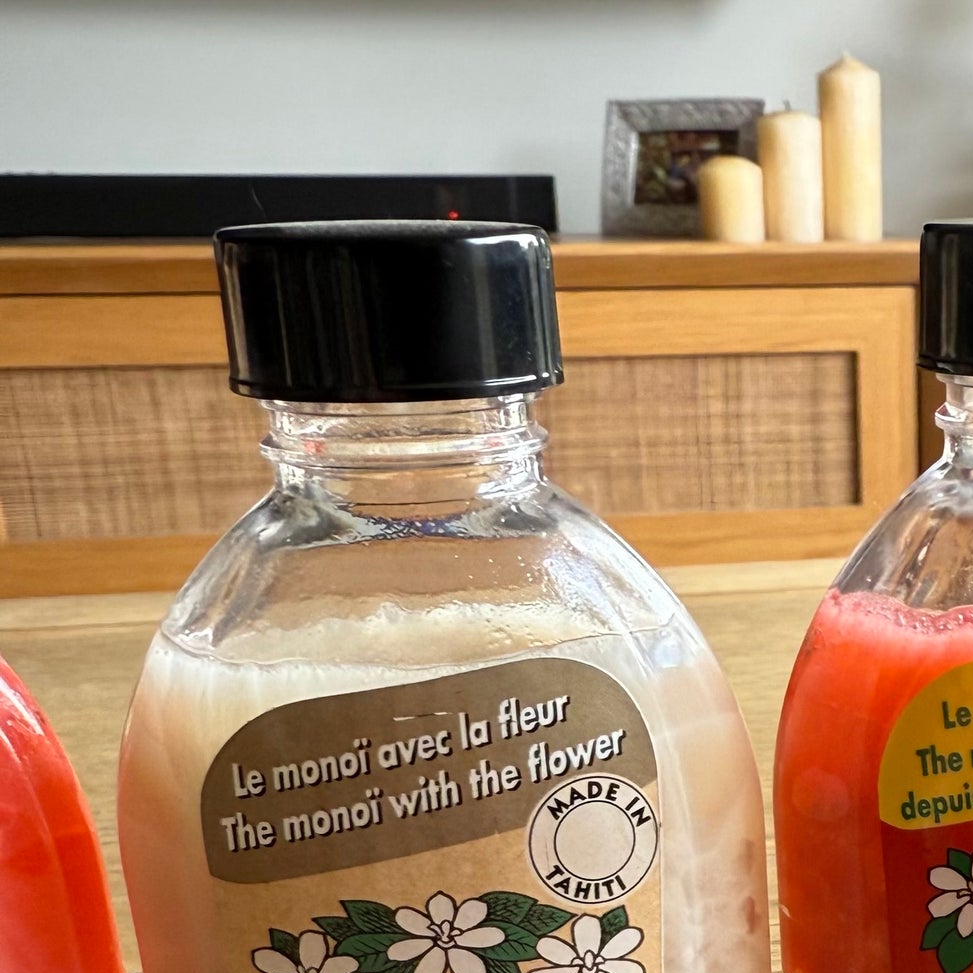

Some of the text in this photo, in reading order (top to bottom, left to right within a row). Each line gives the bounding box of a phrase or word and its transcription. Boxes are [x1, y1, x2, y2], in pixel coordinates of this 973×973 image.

[942, 701, 972, 729] Le
[232, 694, 570, 798] Le monoï avec la fleur
[916, 747, 963, 777] The
[221, 728, 625, 851] The monoï with the flower
[547, 781, 651, 827] MADE IN
[545, 864, 626, 899] TAHITI
